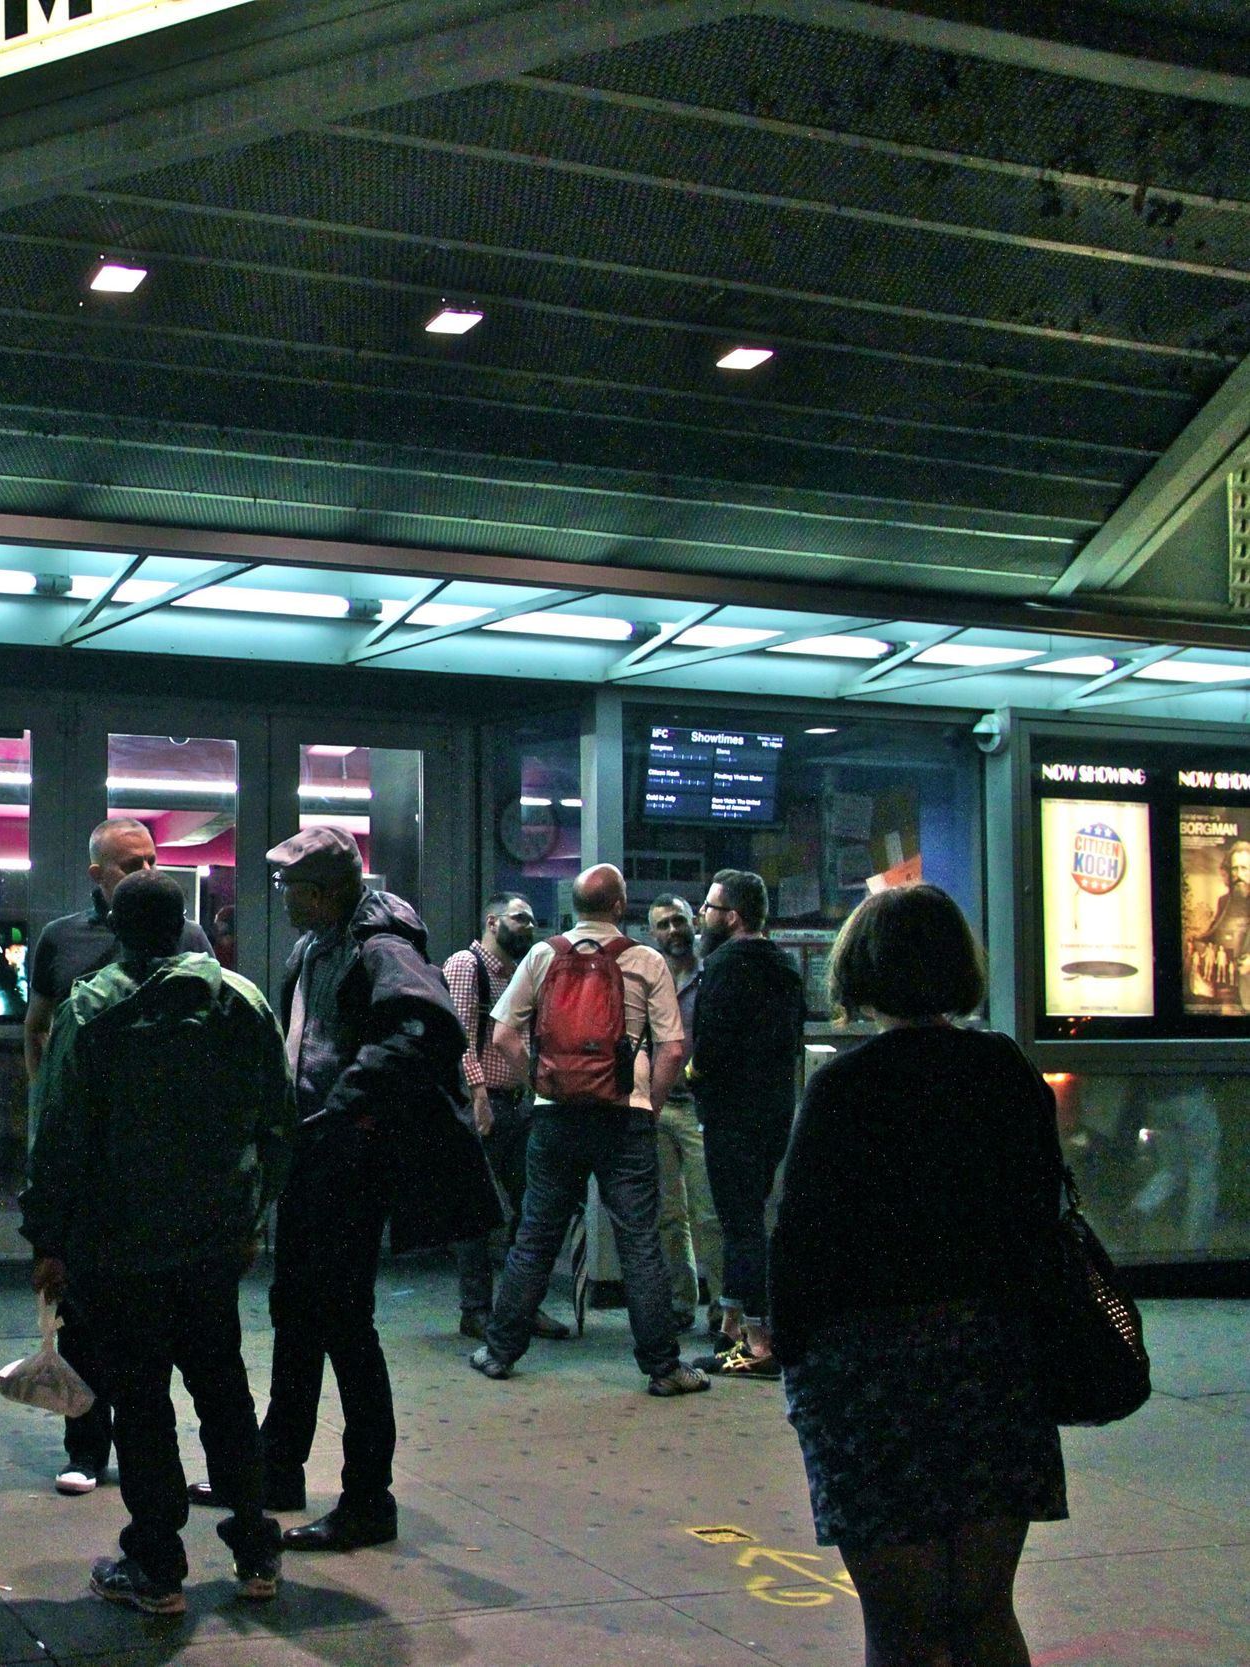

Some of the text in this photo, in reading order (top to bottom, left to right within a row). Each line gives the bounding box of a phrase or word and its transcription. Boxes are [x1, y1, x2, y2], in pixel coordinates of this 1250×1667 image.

[691, 731, 744, 746] Showtimes
[1042, 763, 1146, 785] NOW SHOWING
[1178, 770, 1213, 788] NOW
[1180, 821, 1238, 836] BORGMAN
[1074, 835, 1120, 858] CITIZEN
[1073, 851, 1119, 880] KOCH
